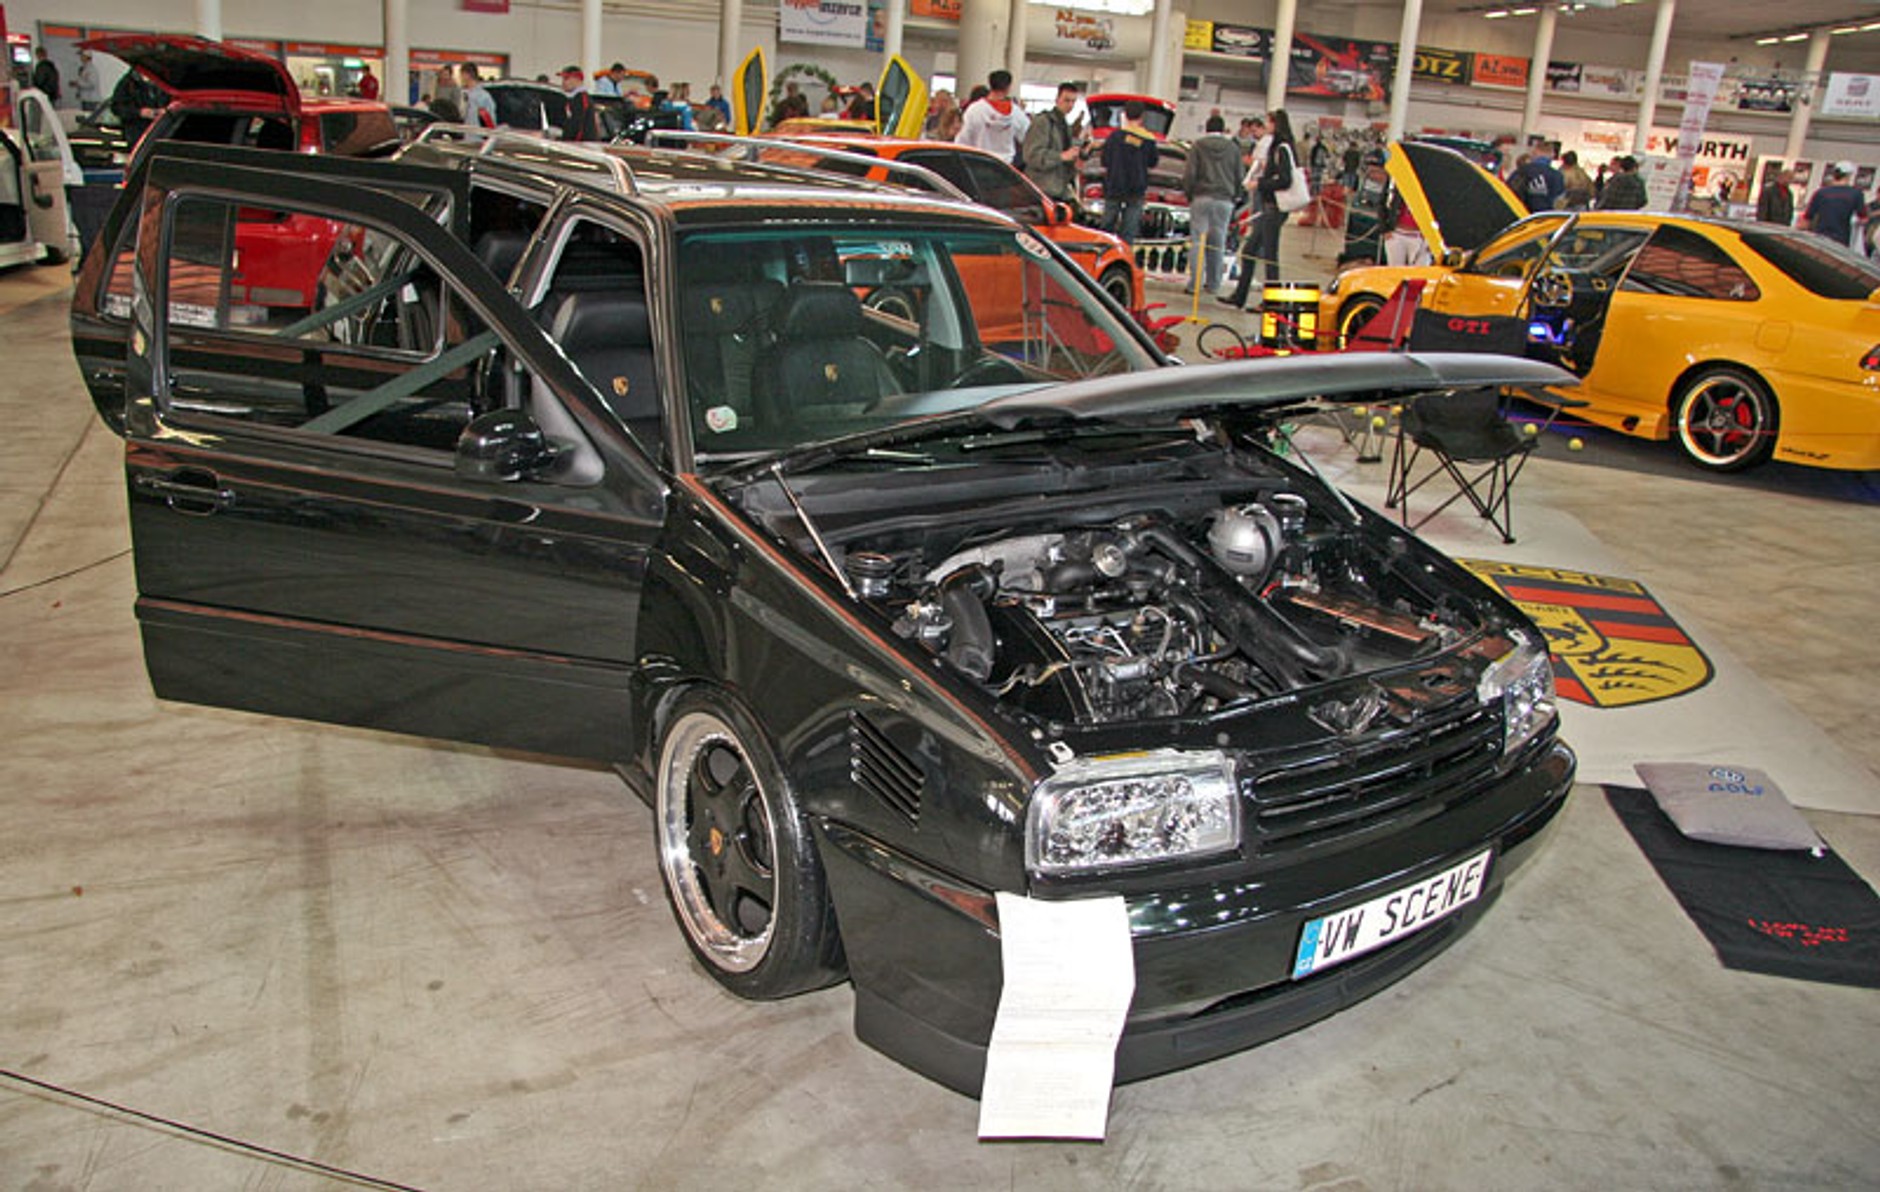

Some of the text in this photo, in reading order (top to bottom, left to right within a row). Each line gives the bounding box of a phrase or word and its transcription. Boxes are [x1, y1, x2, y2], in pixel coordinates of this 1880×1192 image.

[1447, 317, 1491, 336] GTI
[1322, 859, 1482, 960] VW SCENE
